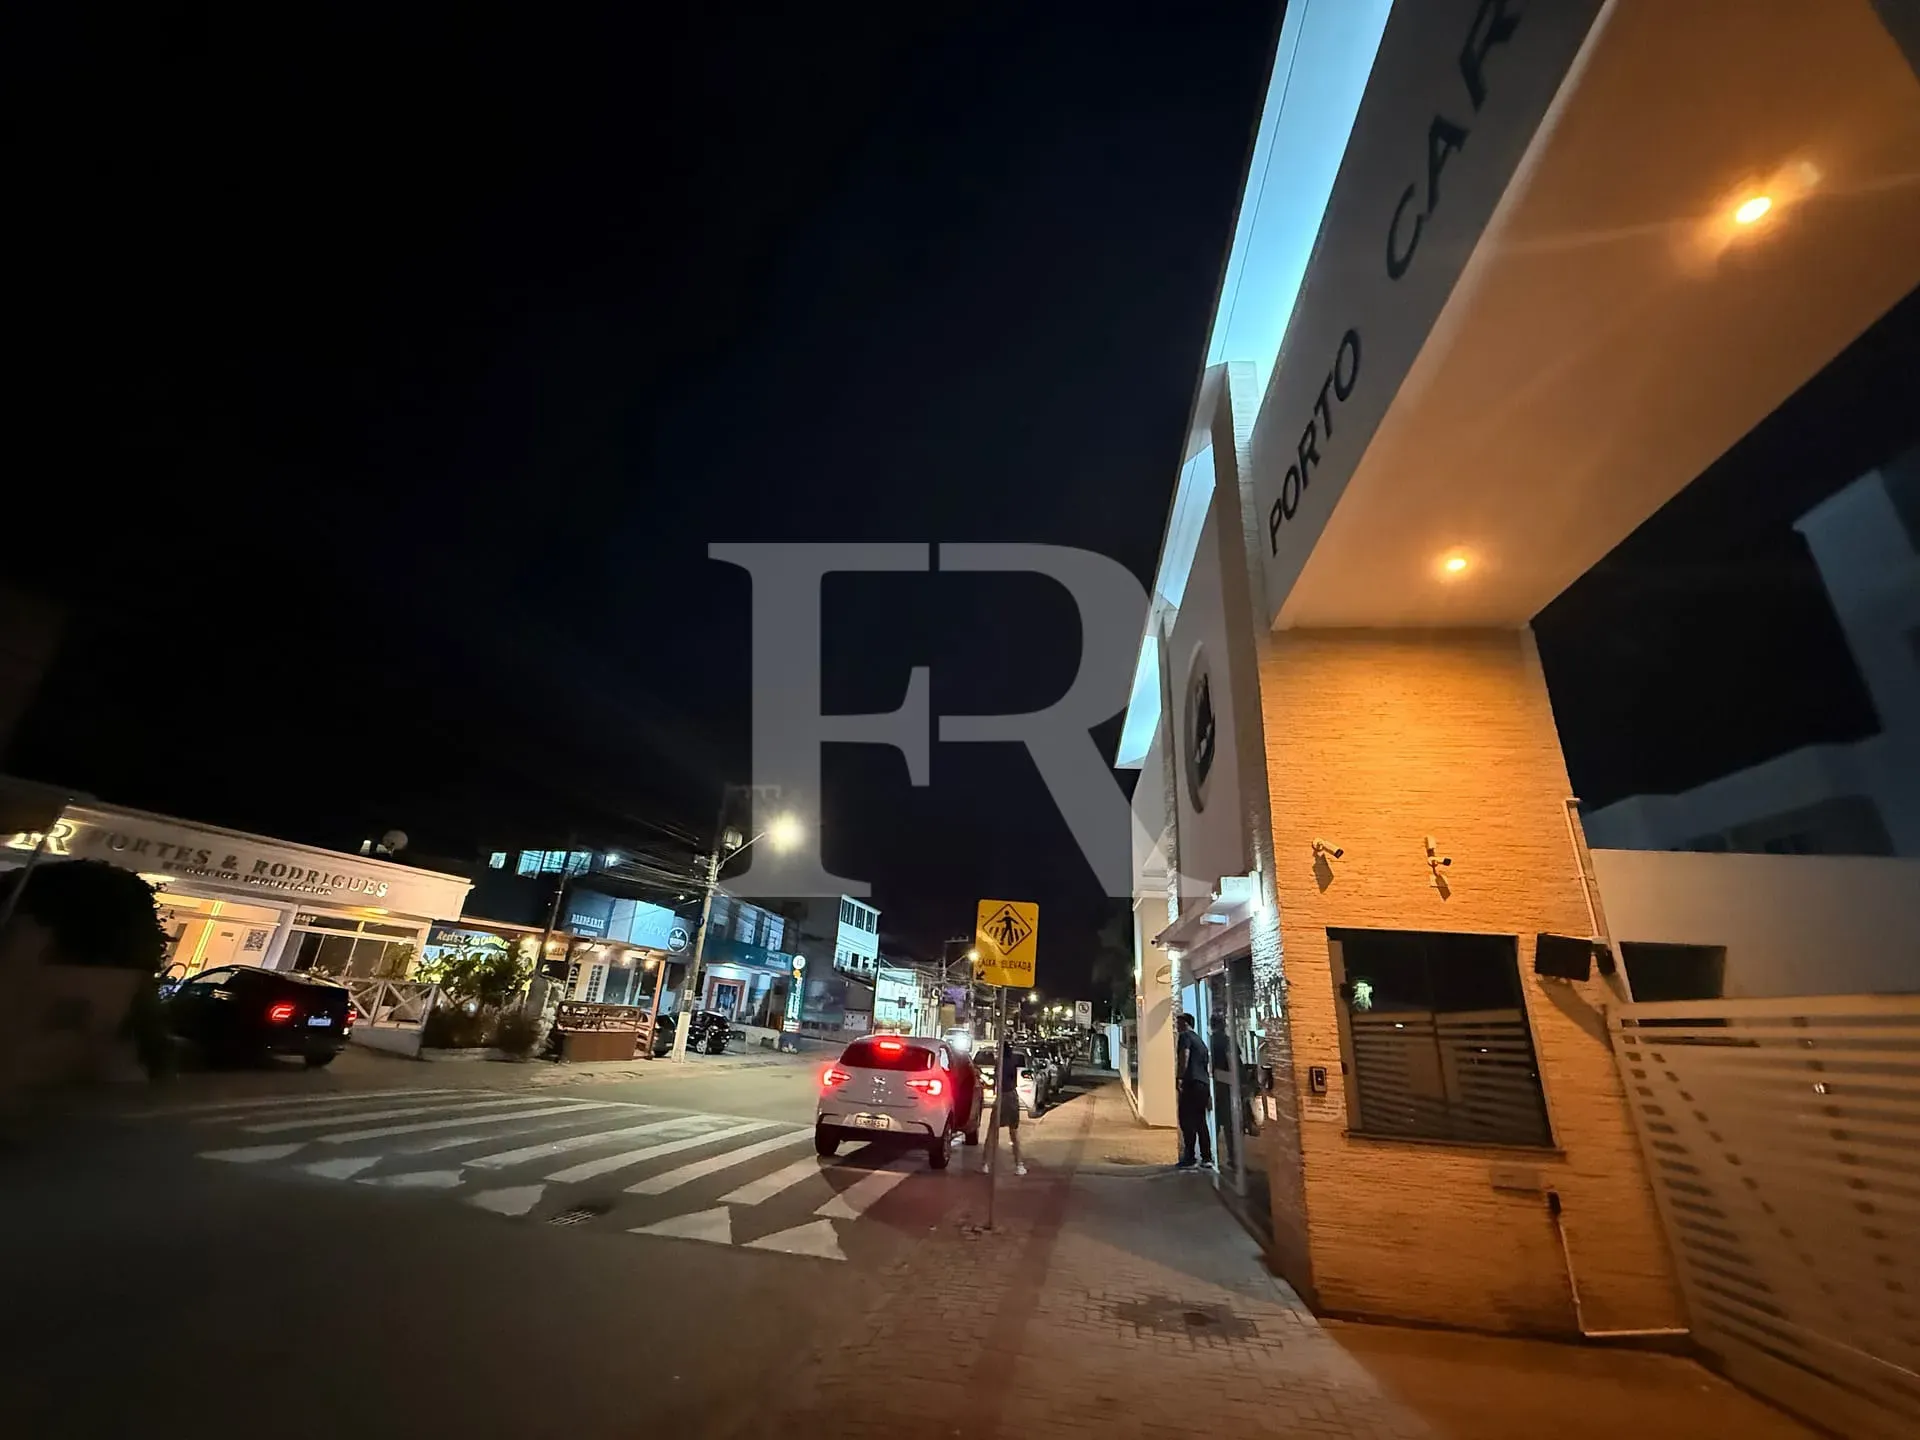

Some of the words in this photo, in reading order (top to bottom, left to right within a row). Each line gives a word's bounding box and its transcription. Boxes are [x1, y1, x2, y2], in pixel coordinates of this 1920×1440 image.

[1269, 328, 1361, 556] PORTO
[222, 855, 237, 871] &
[252, 859, 389, 898] RODRIGUES
